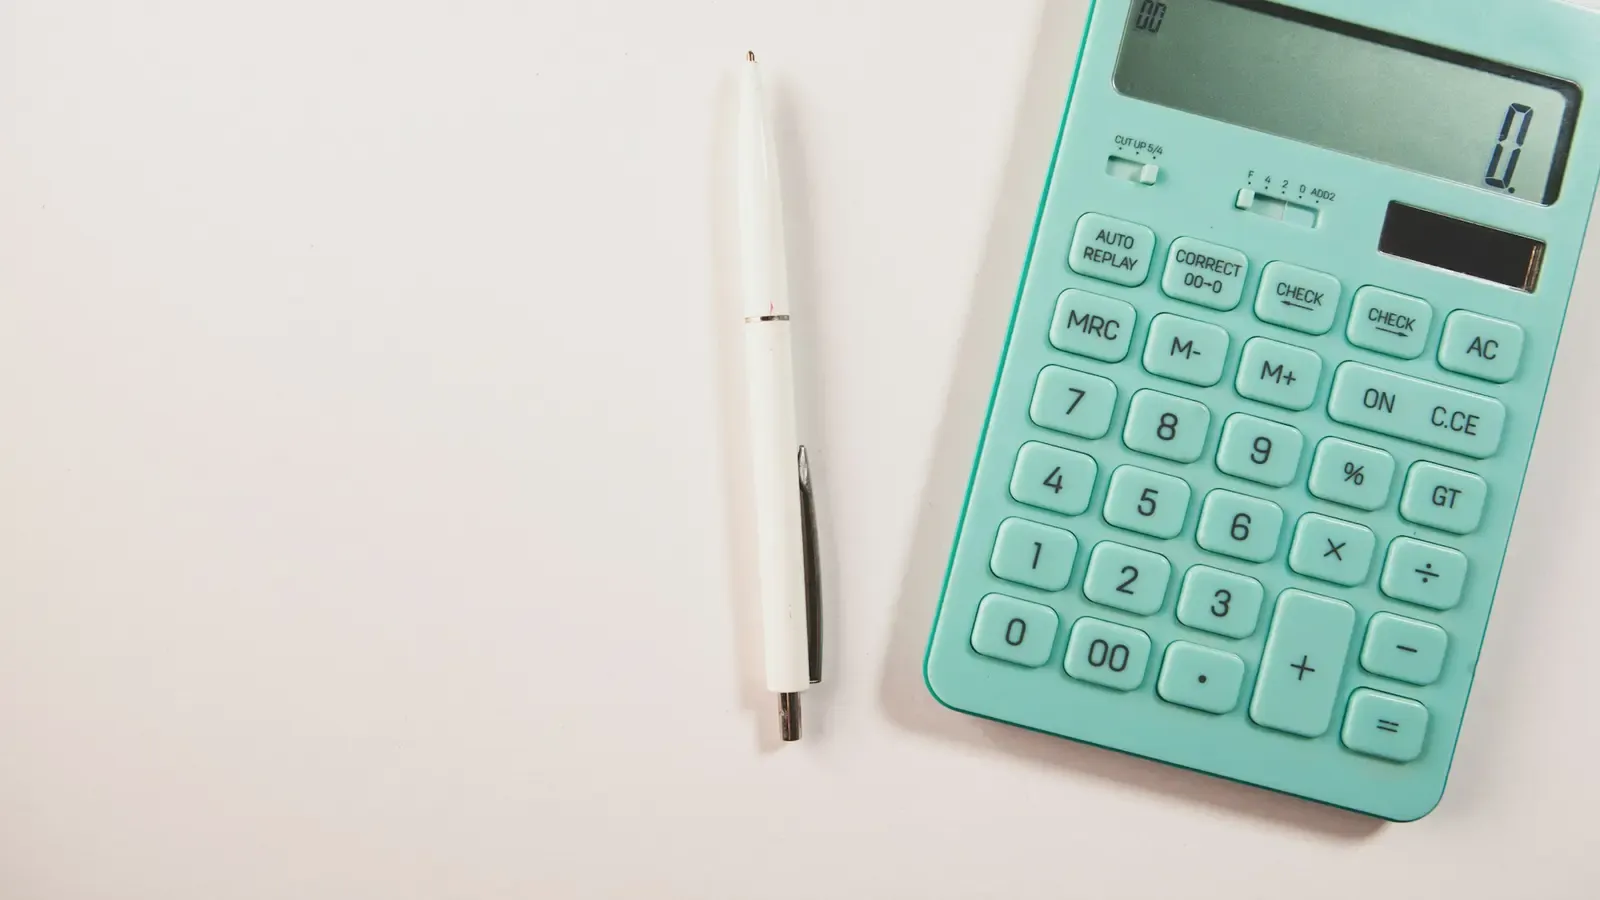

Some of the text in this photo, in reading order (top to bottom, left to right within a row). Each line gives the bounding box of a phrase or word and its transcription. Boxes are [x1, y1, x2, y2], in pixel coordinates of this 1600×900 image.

[1114, 134, 1164, 156] CUT UP 5/4
[1247, 170, 1255, 179] F
[1264, 175, 1272, 184] 4
[1282, 179, 1289, 189] 2
[1310, 188, 1336, 202] ADD2
[1095, 229, 1135, 250] AUTO
[1083, 246, 1138, 271] REPLAY
[1175, 248, 1243, 278] CORRECT
[1276, 282, 1325, 307] CHECK
[1066, 309, 1120, 341] MRC
[1367, 307, 1416, 333] CHECK
[1170, 336, 1201, 360] M-
[1466, 336, 1499, 361] AC
[1260, 360, 1297, 386] M+
[1065, 387, 1086, 416] 7
[1363, 387, 1480, 436] ON C.CE
[1156, 412, 1179, 442] 8
[1250, 436, 1273, 465] 9
[1042, 466, 1063, 495] 4
[1343, 461, 1365, 486] %
[1137, 487, 1159, 517] 5
[1431, 485, 1463, 509] GT
[1230, 512, 1252, 542] 6
[1031, 541, 1043, 570] 1
[1115, 565, 1139, 596] 2
[1210, 588, 1232, 618] 3
[1004, 617, 1027, 647] 0
[1087, 638, 1130, 673] 00
